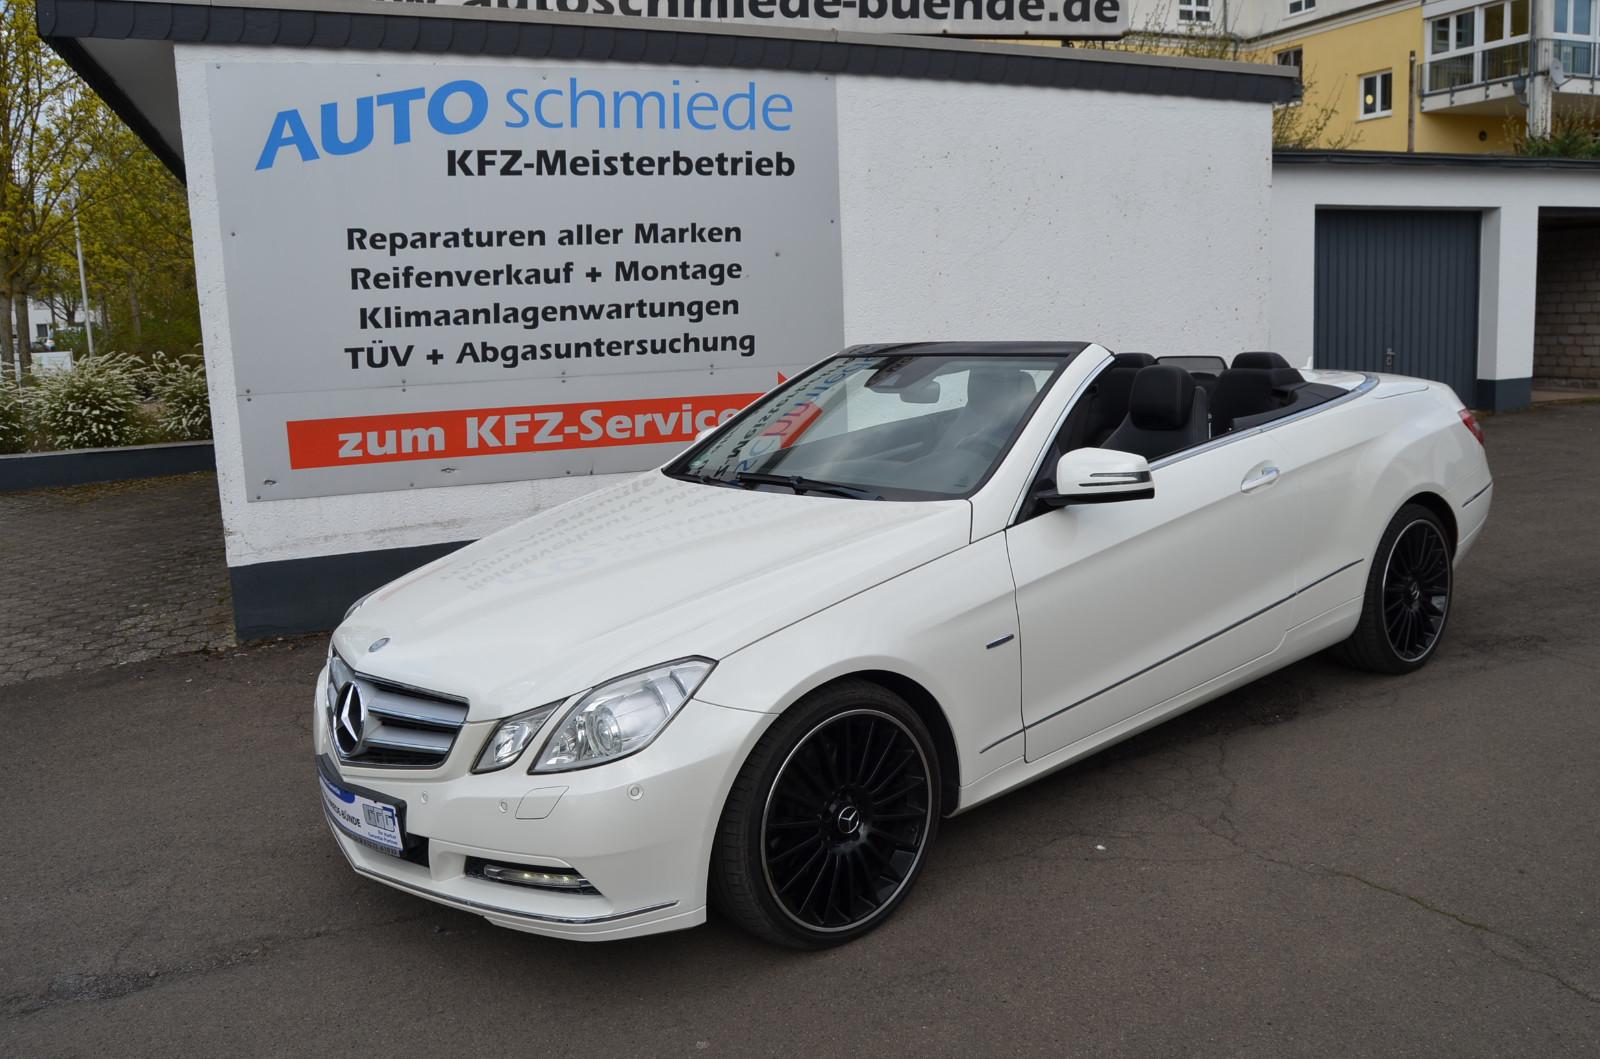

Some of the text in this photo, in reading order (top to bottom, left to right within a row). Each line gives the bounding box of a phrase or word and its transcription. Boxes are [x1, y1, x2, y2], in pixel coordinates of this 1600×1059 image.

[255, 75, 796, 172] AUTO schmiede
[447, 149, 796, 177] KFZ-Meisterbetrieb
[346, 222, 742, 257] Reparaturen aller Marken
[350, 260, 743, 290] Reifenverkauf + Montage
[359, 298, 739, 330] Klimaanlagenwartungen
[343, 332, 756, 370] TÜV + Abgasuntersuchung
[338, 426, 446, 458] zum
